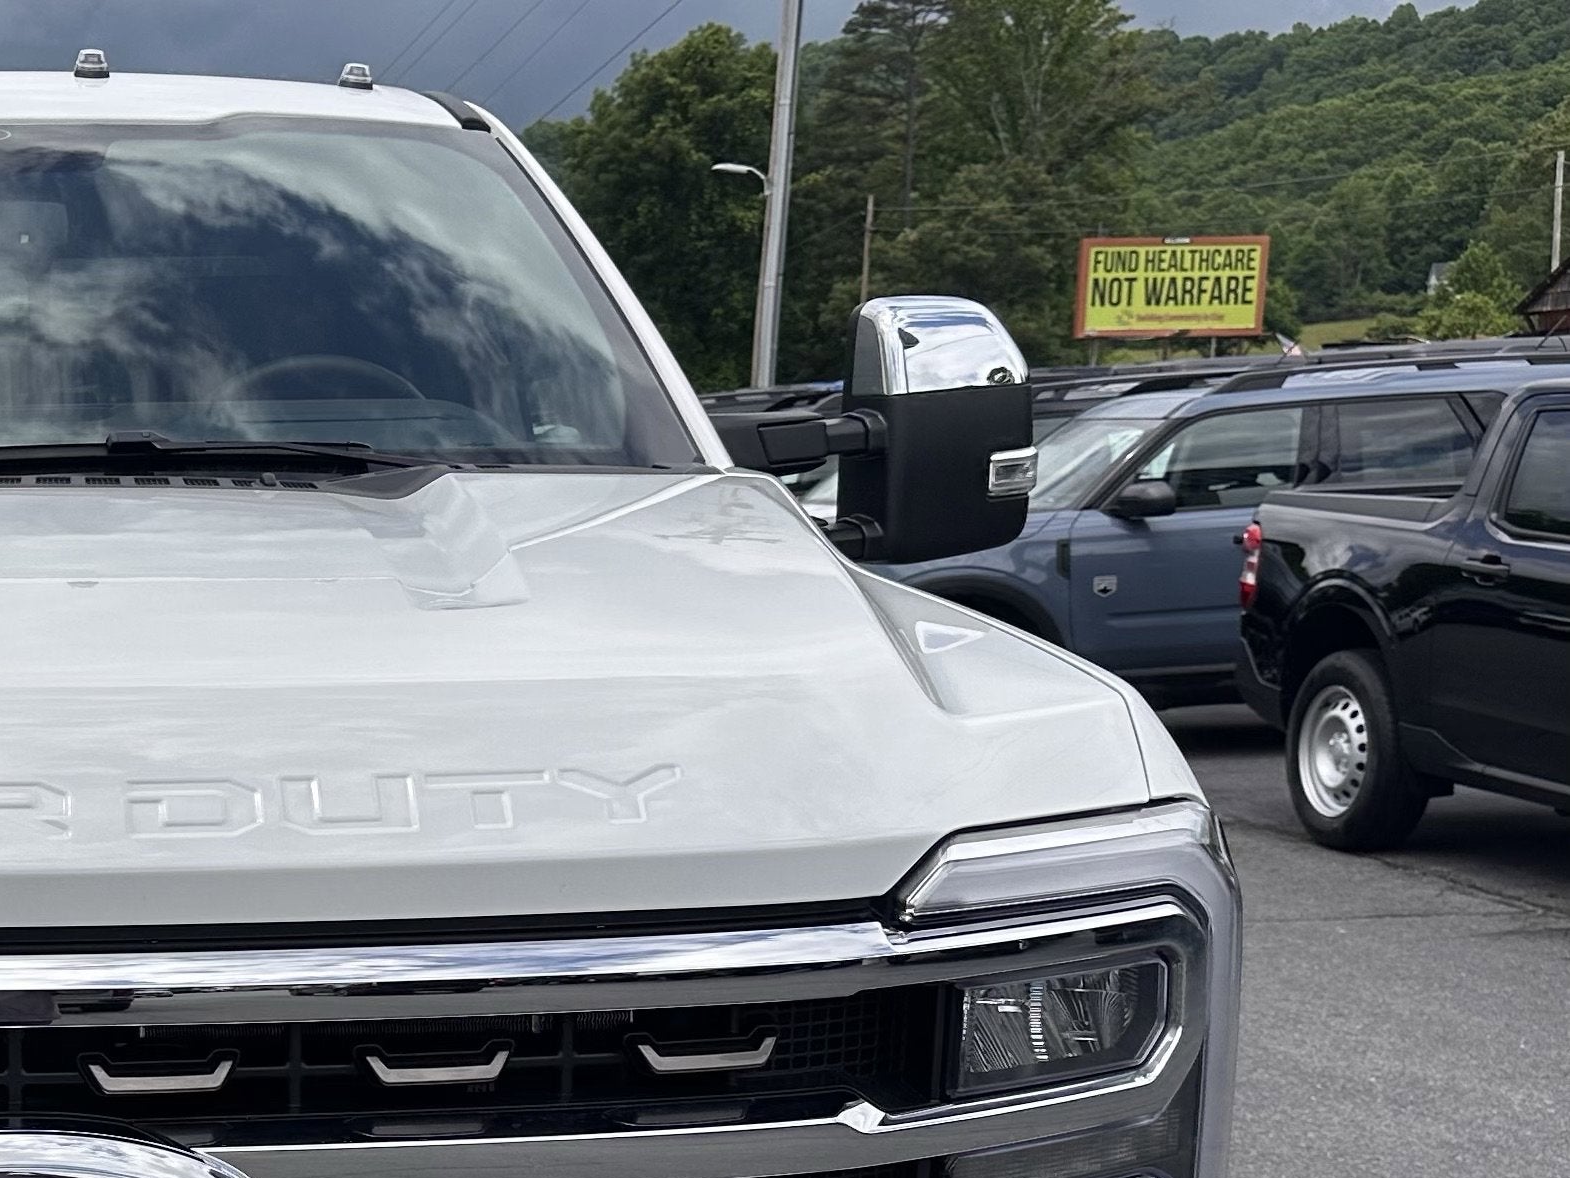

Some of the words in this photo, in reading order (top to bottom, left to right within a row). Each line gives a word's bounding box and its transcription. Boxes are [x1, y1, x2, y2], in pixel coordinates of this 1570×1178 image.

[1093, 250, 1139, 273] FUND
[1144, 248, 1257, 272] HEALTHCARE
[1091, 277, 1138, 307] NOT
[1144, 275, 1255, 306] WARFARE
[123, 763, 683, 839] DUTY
